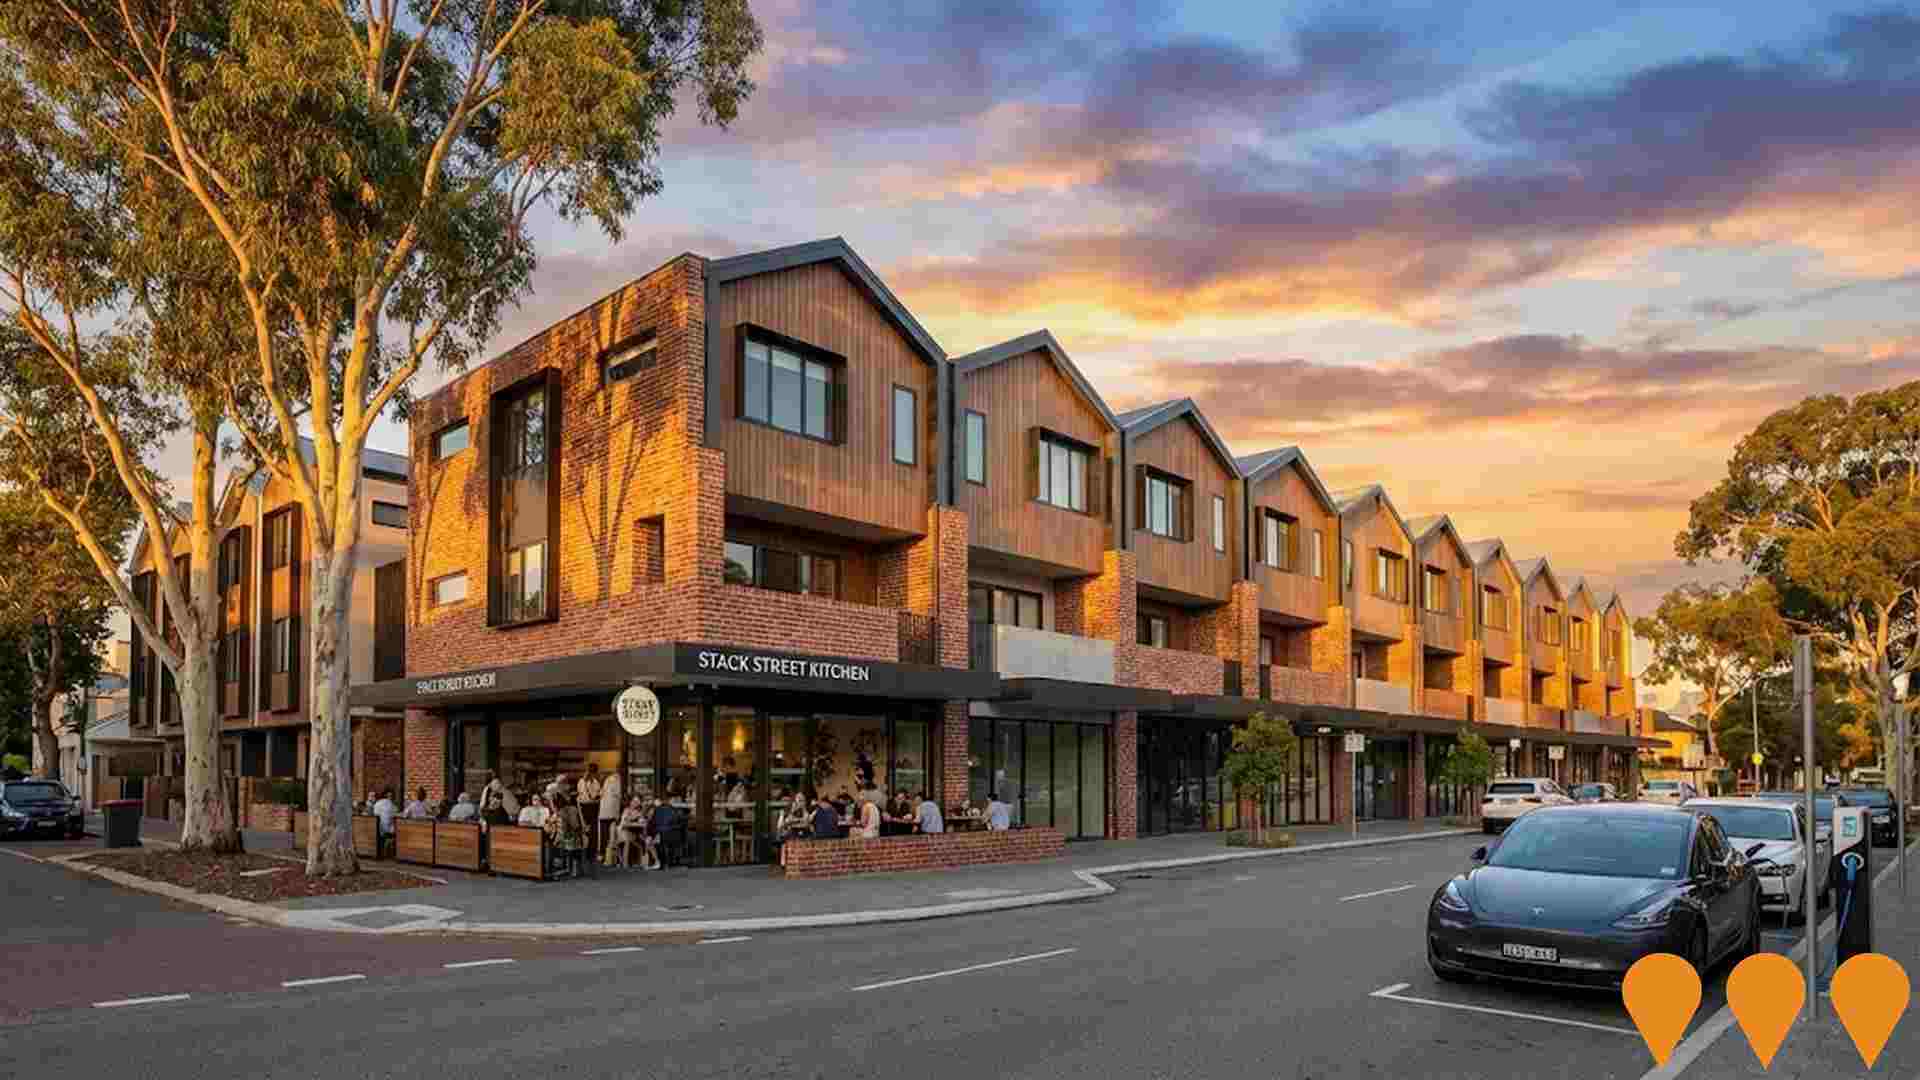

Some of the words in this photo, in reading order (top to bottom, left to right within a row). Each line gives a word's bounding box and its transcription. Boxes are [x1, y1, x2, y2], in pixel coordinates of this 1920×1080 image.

[699, 651, 749, 671] STACK
[752, 656, 808, 676] STREET
[809, 662, 871, 681] KITCHEN
